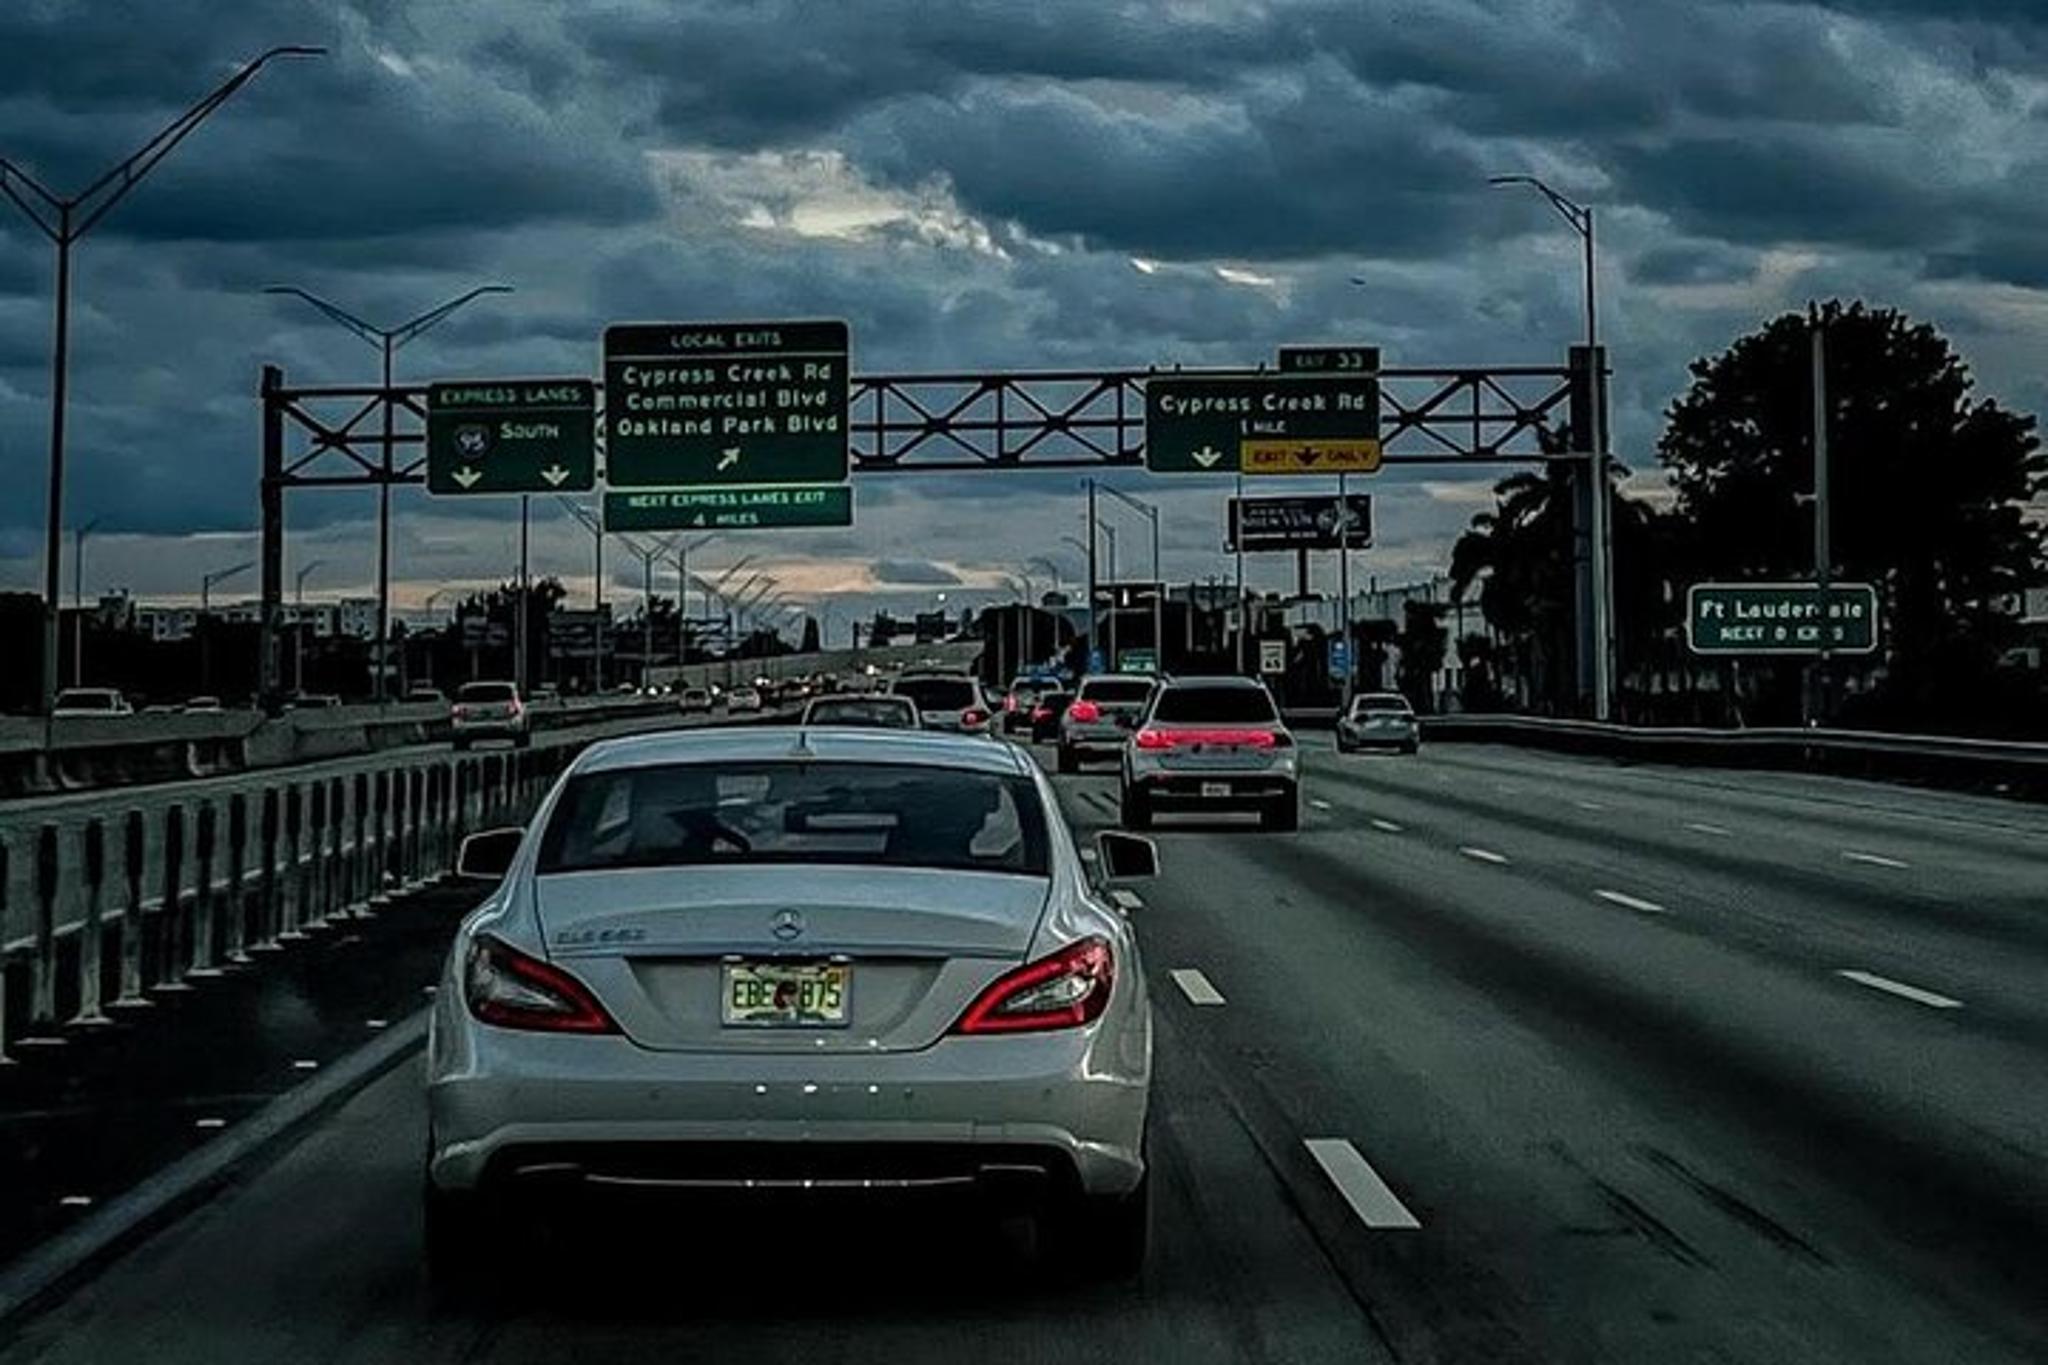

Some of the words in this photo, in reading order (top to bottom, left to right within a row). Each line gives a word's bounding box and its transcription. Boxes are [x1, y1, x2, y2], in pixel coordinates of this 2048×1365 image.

[671, 333, 726, 348] LOCAL
[735, 331, 782, 347] EXITS
[1338, 352, 1364, 367] 33
[622, 365, 716, 389] Cypress
[727, 363, 791, 382] Creek
[804, 363, 832, 381] Rd
[440, 388, 516, 405] EXPRESS
[525, 386, 582, 402] LANES
[627, 391, 768, 411] Commercial
[777, 390, 827, 408] Blvd
[1160, 394, 1251, 415] Cypress
[1262, 392, 1327, 412] Creek
[1337, 392, 1366, 411] Rd
[617, 417, 712, 437] Oakland
[723, 416, 775, 434] Park
[787, 414, 838, 432] Blvd
[1240, 420, 1248, 435] 1
[1253, 421, 1287, 433] MILE
[1254, 450, 1287, 463] EXIT
[1327, 448, 1370, 462] ONLY
[629, 494, 667, 507] NEXT
[671, 493, 736, 507] EXPRESS
[740, 492, 789, 506] LANES
[794, 491, 826, 505] EXIT
[693, 513, 707, 526] 4
[715, 512, 759, 526] MILES
[1700, 599, 1725, 619] Ft
[1720, 627, 1764, 640] NEXT
